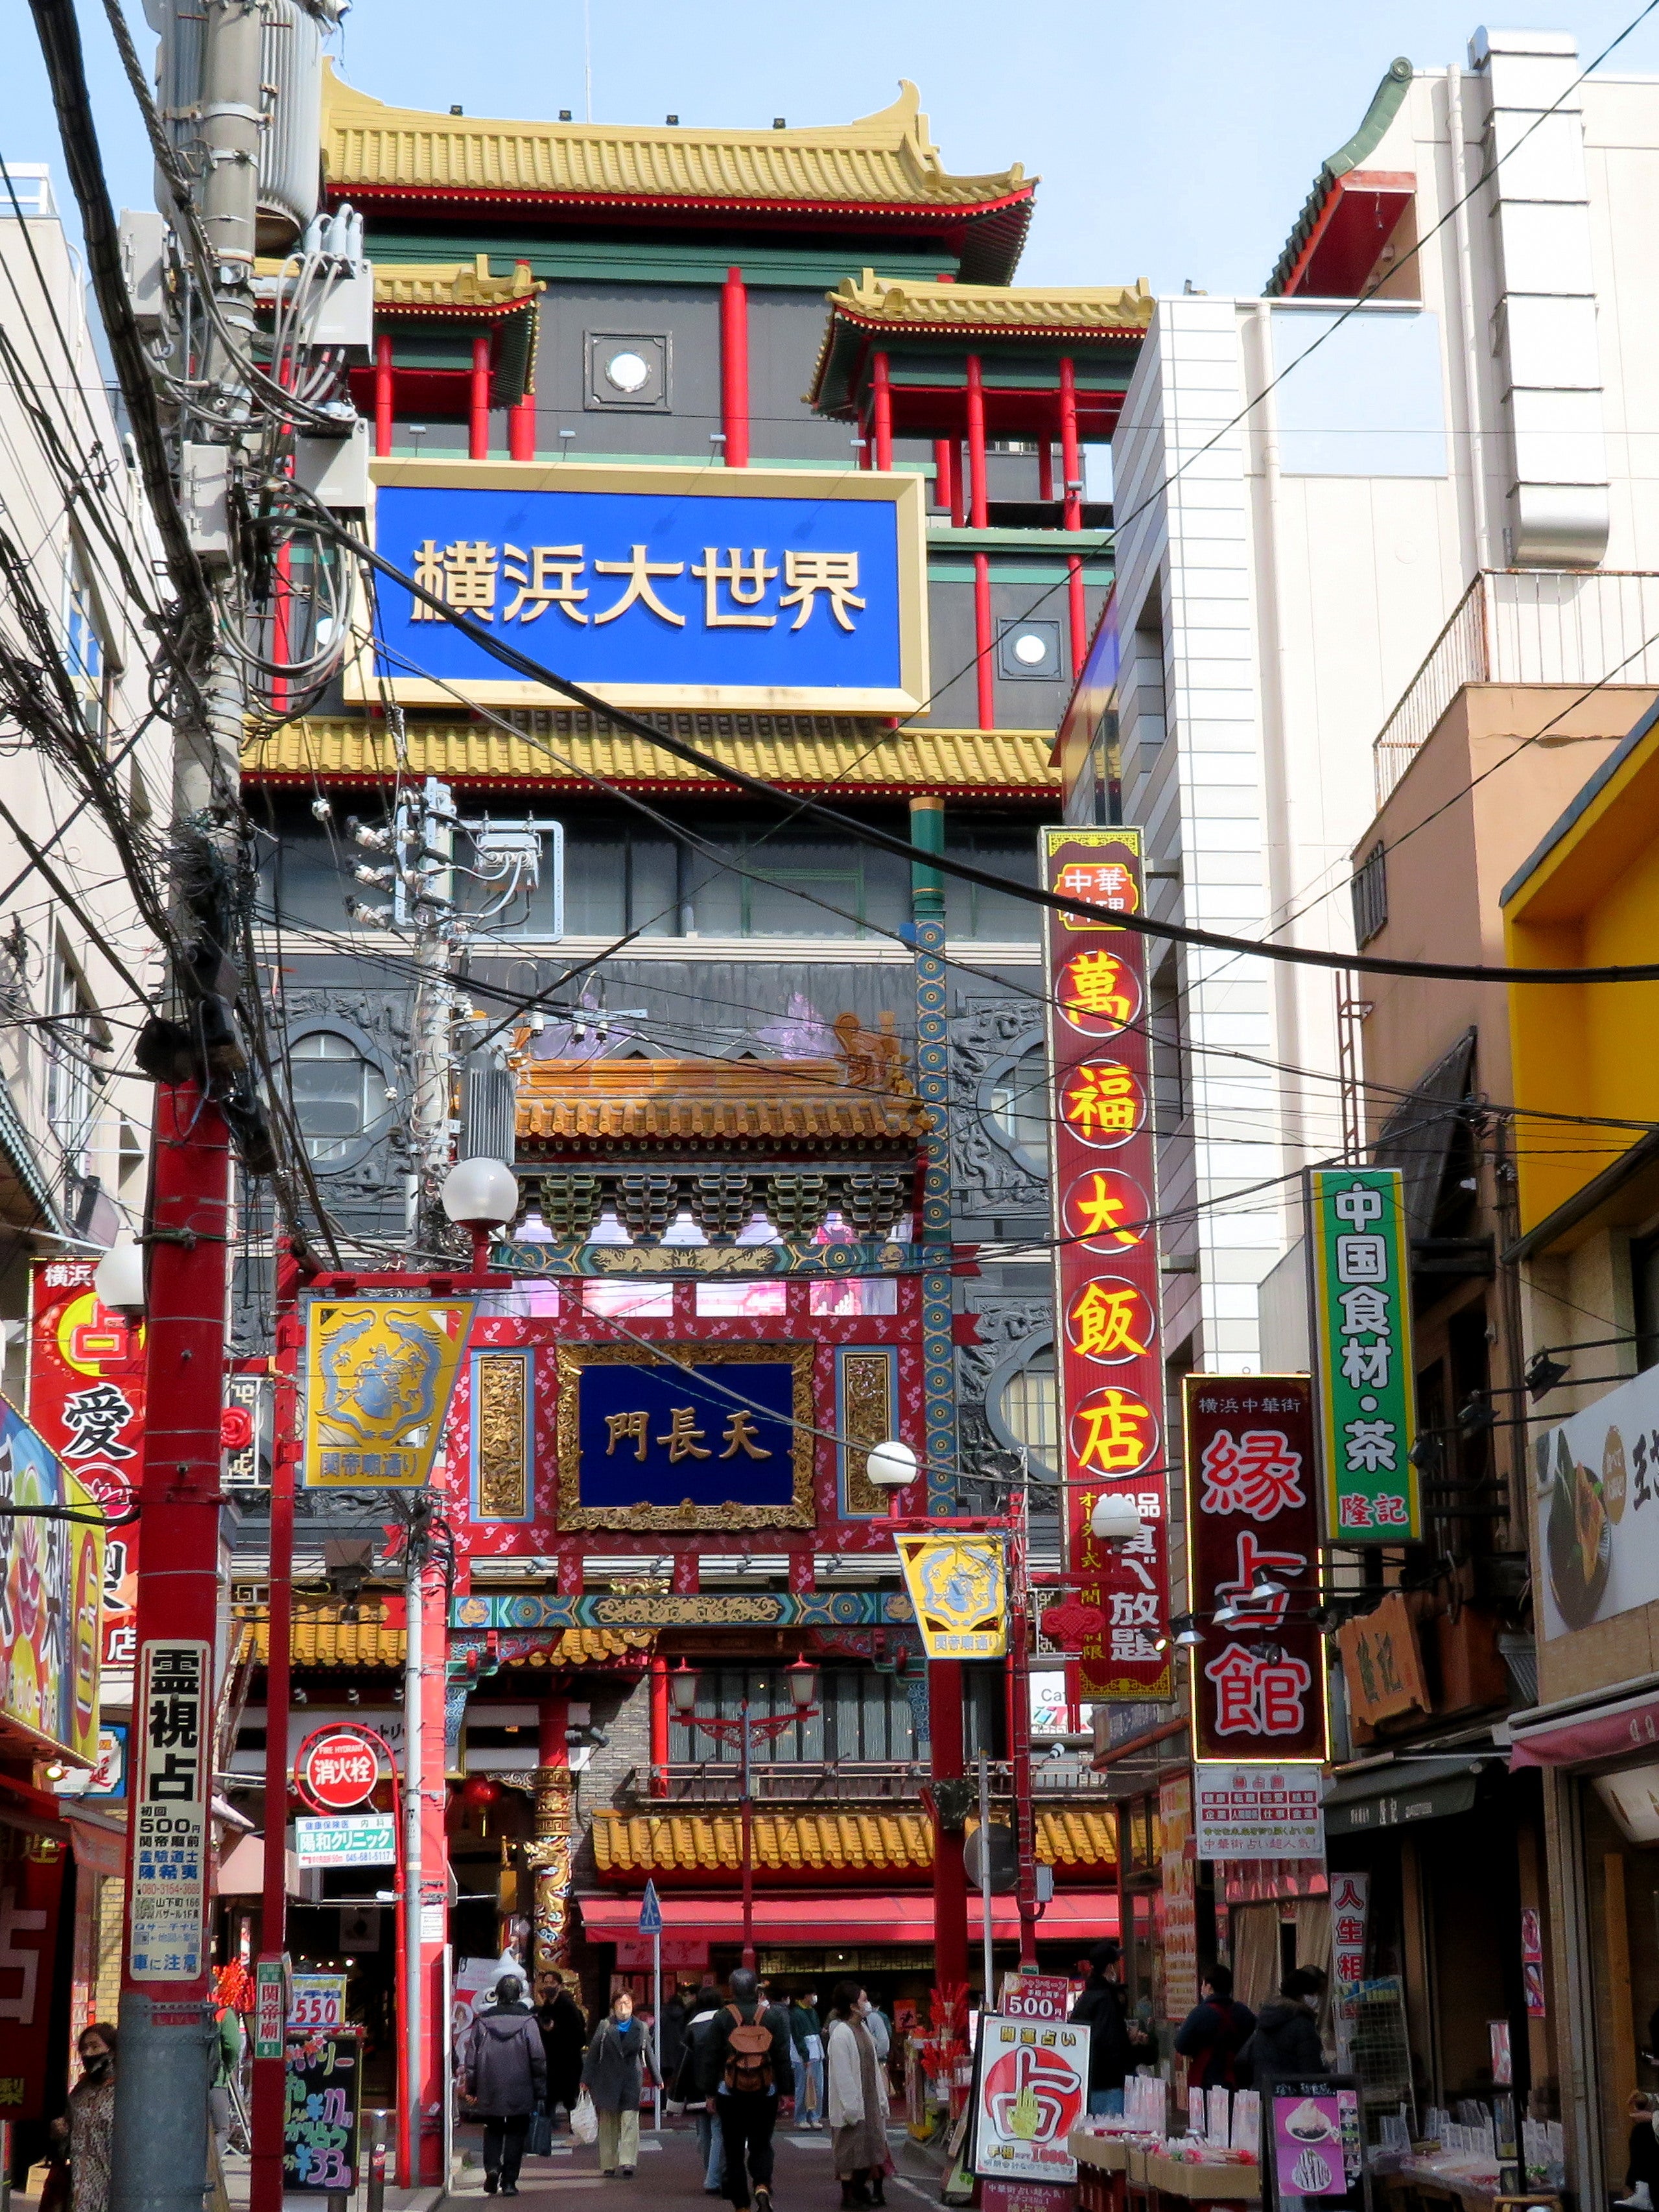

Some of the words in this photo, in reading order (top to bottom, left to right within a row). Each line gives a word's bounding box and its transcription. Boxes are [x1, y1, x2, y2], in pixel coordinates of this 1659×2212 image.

[410, 539, 867, 631] 横浜大世界
[1065, 867, 1127, 896] 中華
[1064, 950, 1151, 1471] 萬福大飯店
[1335, 1182, 1398, 1473] 中国食材・茶
[1199, 1396, 1301, 1414] 横浜中華街
[1339, 1494, 1408, 1528] 隆記
[1201, 1430, 1311, 1737] 縁占館
[1041, 1688, 1066, 1702] Ca
[149, 1649, 200, 1802] 霊視占
[318, 1746, 334, 1755] FIRE
[335, 1744, 364, 1754] HYDRANT
[314, 1755, 372, 1786] 消火栓
[139, 1818, 200, 1833] 500円
[141, 1806, 167, 1816] 初回
[300, 1829, 390, 1853] 陽和クリニック
